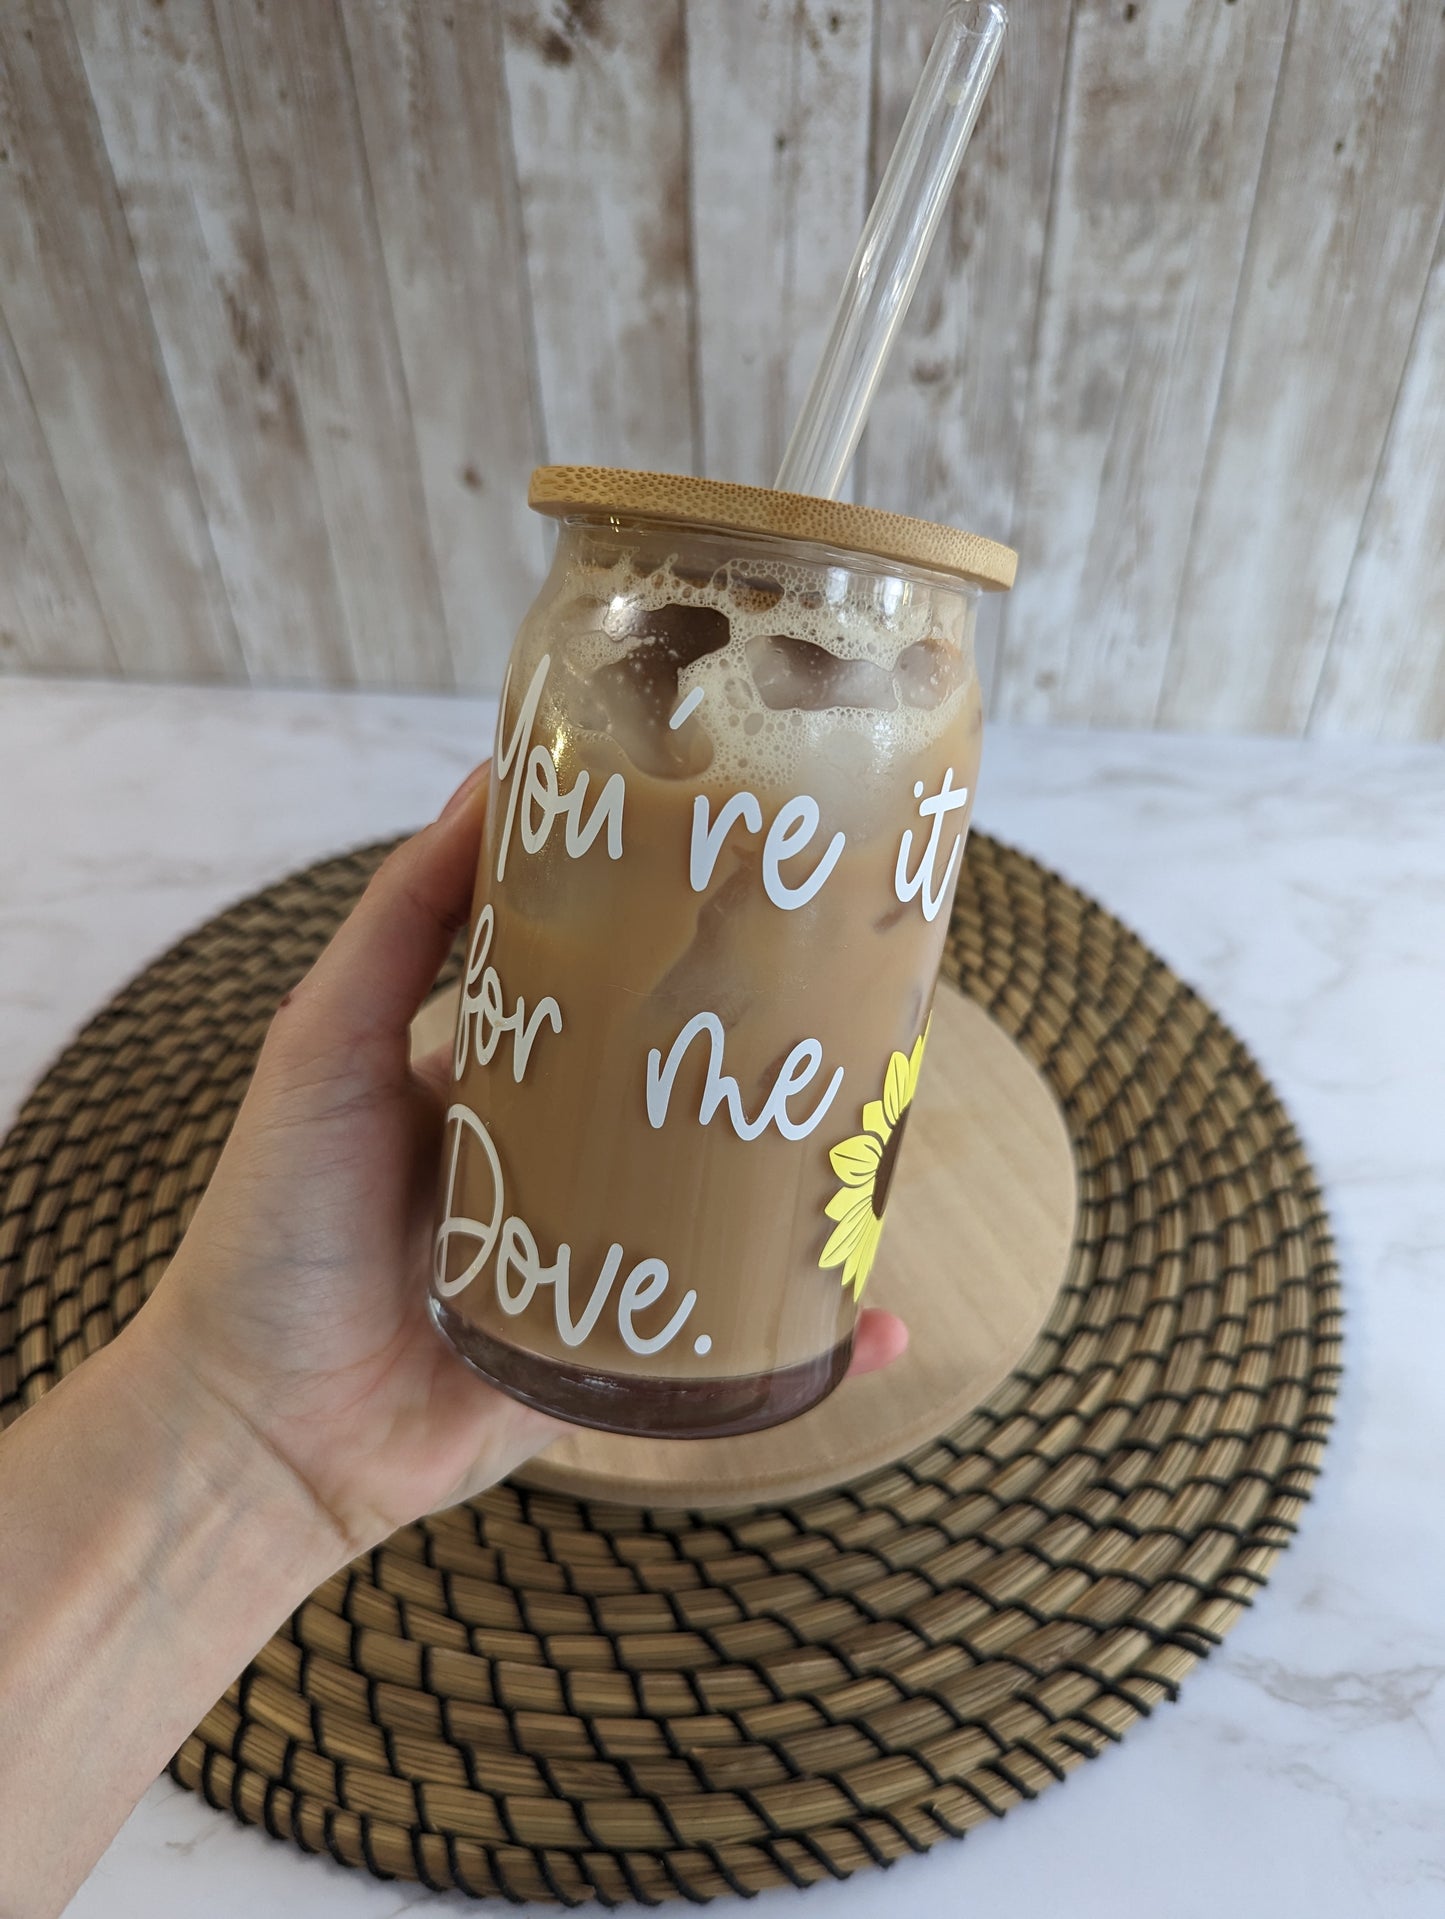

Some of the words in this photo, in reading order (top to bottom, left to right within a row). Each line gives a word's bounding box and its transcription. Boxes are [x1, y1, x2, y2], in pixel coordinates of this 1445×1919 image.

[895, 767, 969, 922] it
[454, 904, 563, 1082] for
[646, 1011, 845, 1141] me
[434, 1103, 712, 1355] Dove.
